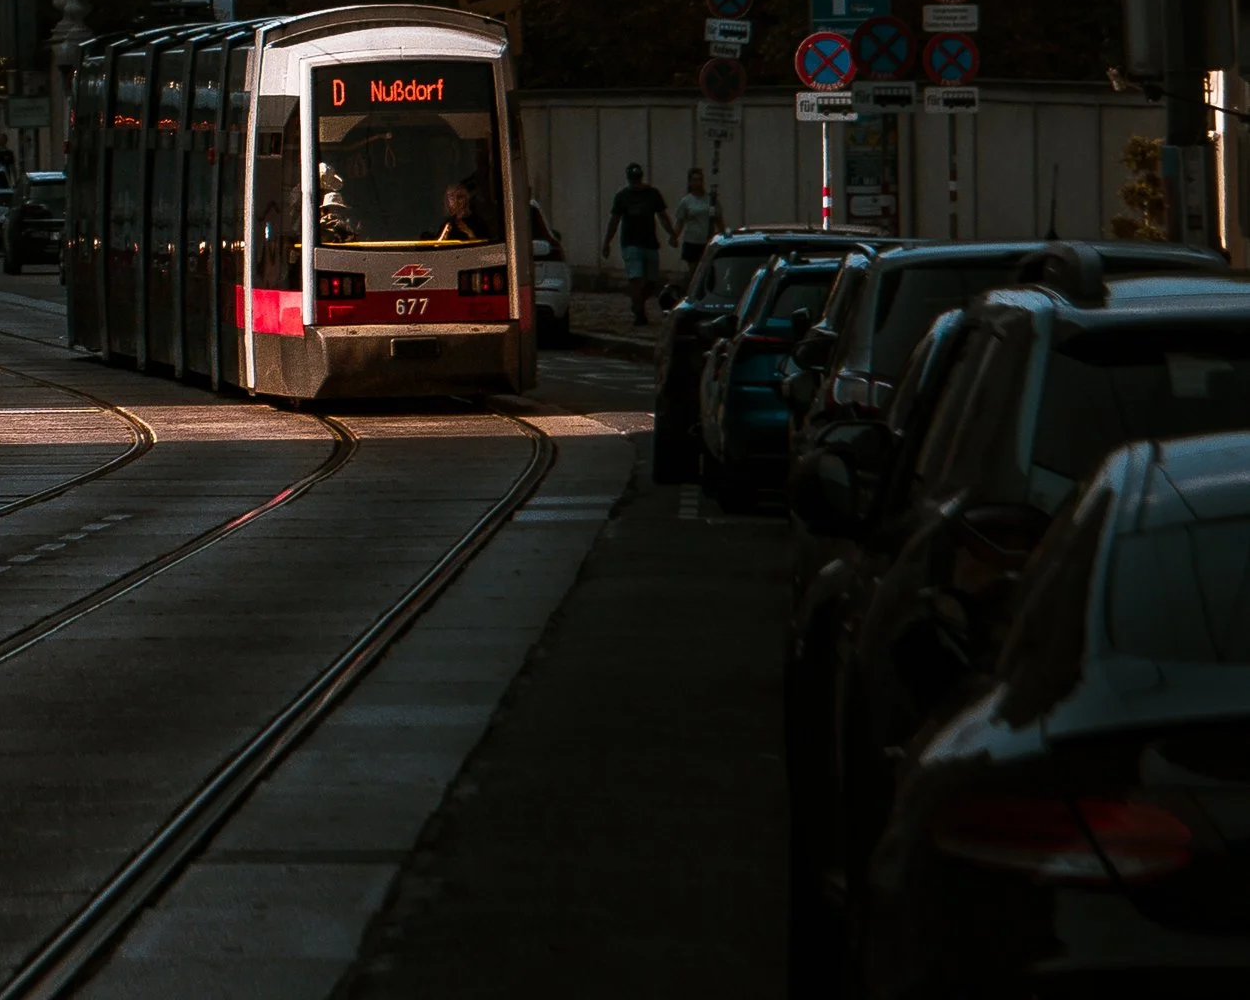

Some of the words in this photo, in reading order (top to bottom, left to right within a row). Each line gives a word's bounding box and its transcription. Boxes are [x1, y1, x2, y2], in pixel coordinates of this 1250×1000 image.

[810, 80, 846, 91] ANFANG
[331, 79, 346, 108] D
[370, 78, 446, 103] Nußdorf
[855, 89, 871, 103] für
[800, 100, 816, 113] für
[395, 297, 430, 316] 677
